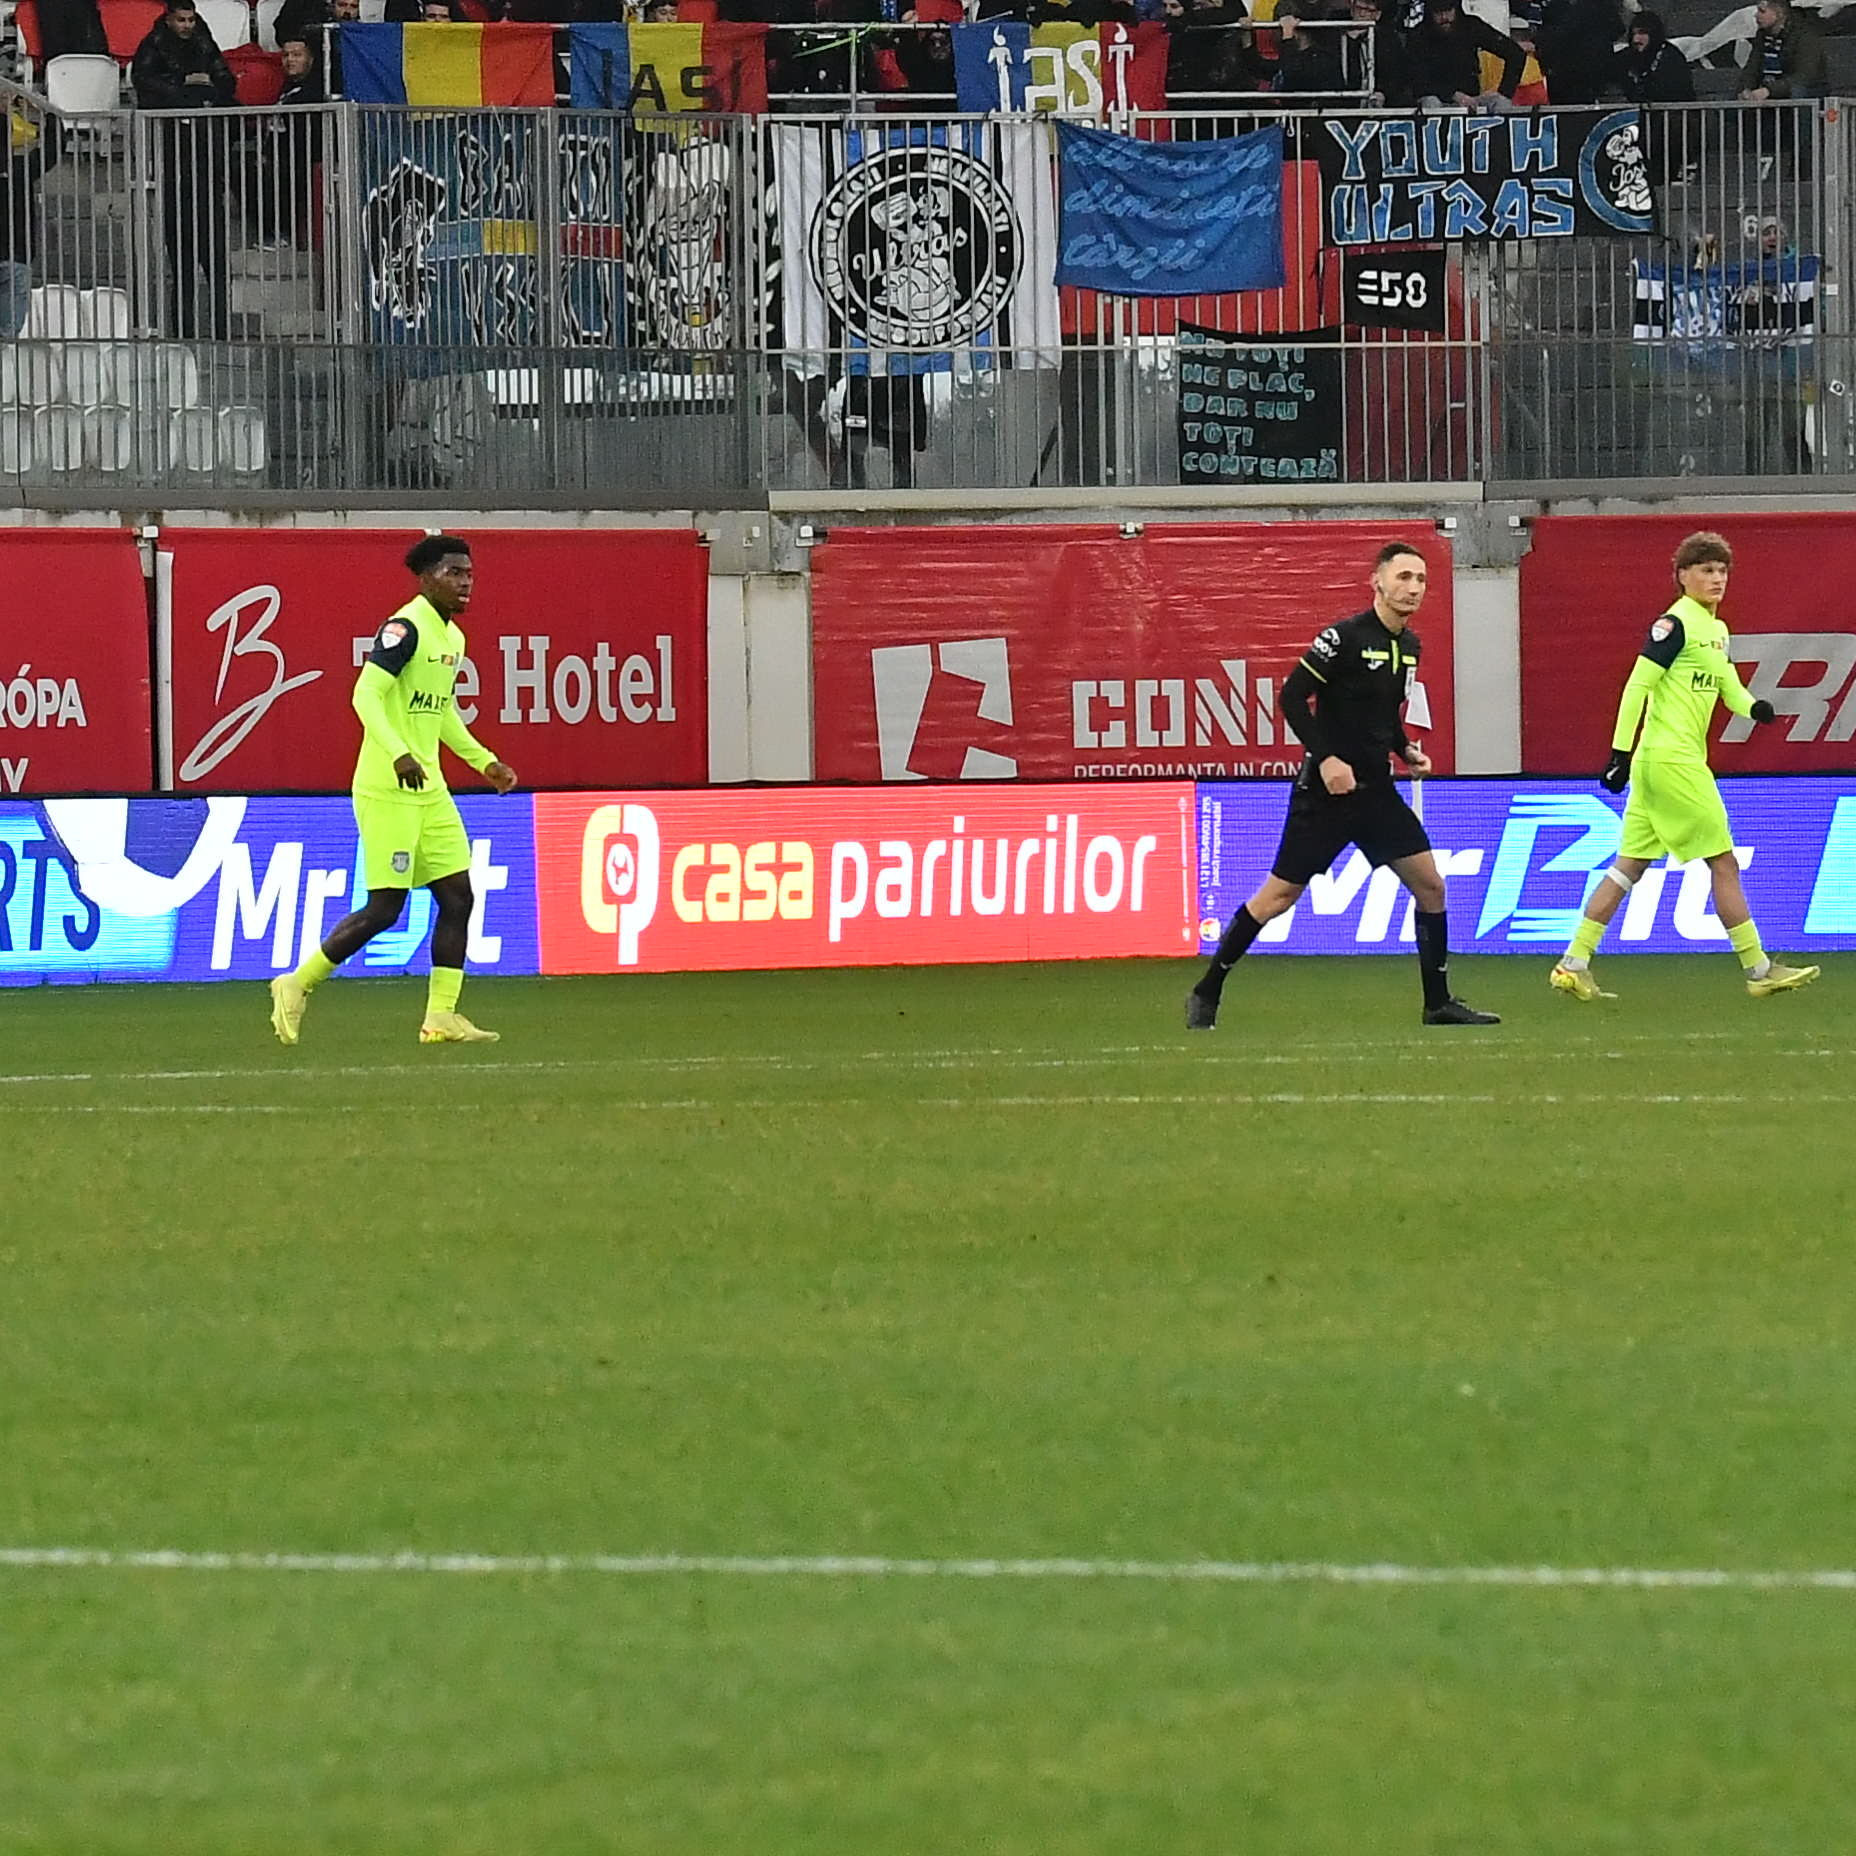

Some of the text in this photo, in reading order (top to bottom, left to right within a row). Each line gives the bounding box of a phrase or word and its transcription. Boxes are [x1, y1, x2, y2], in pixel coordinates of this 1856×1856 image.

[1324, 114, 1559, 180] YOUTH
[1330, 176, 1576, 245] ULTRAS
[1181, 363, 1316, 402] NE PLAC,
[1183, 392, 1299, 421] DAR NU
[497, 634, 677, 726] Hotel
[671, 841, 815, 923] casa
[828, 813, 1159, 943] pariurilor
